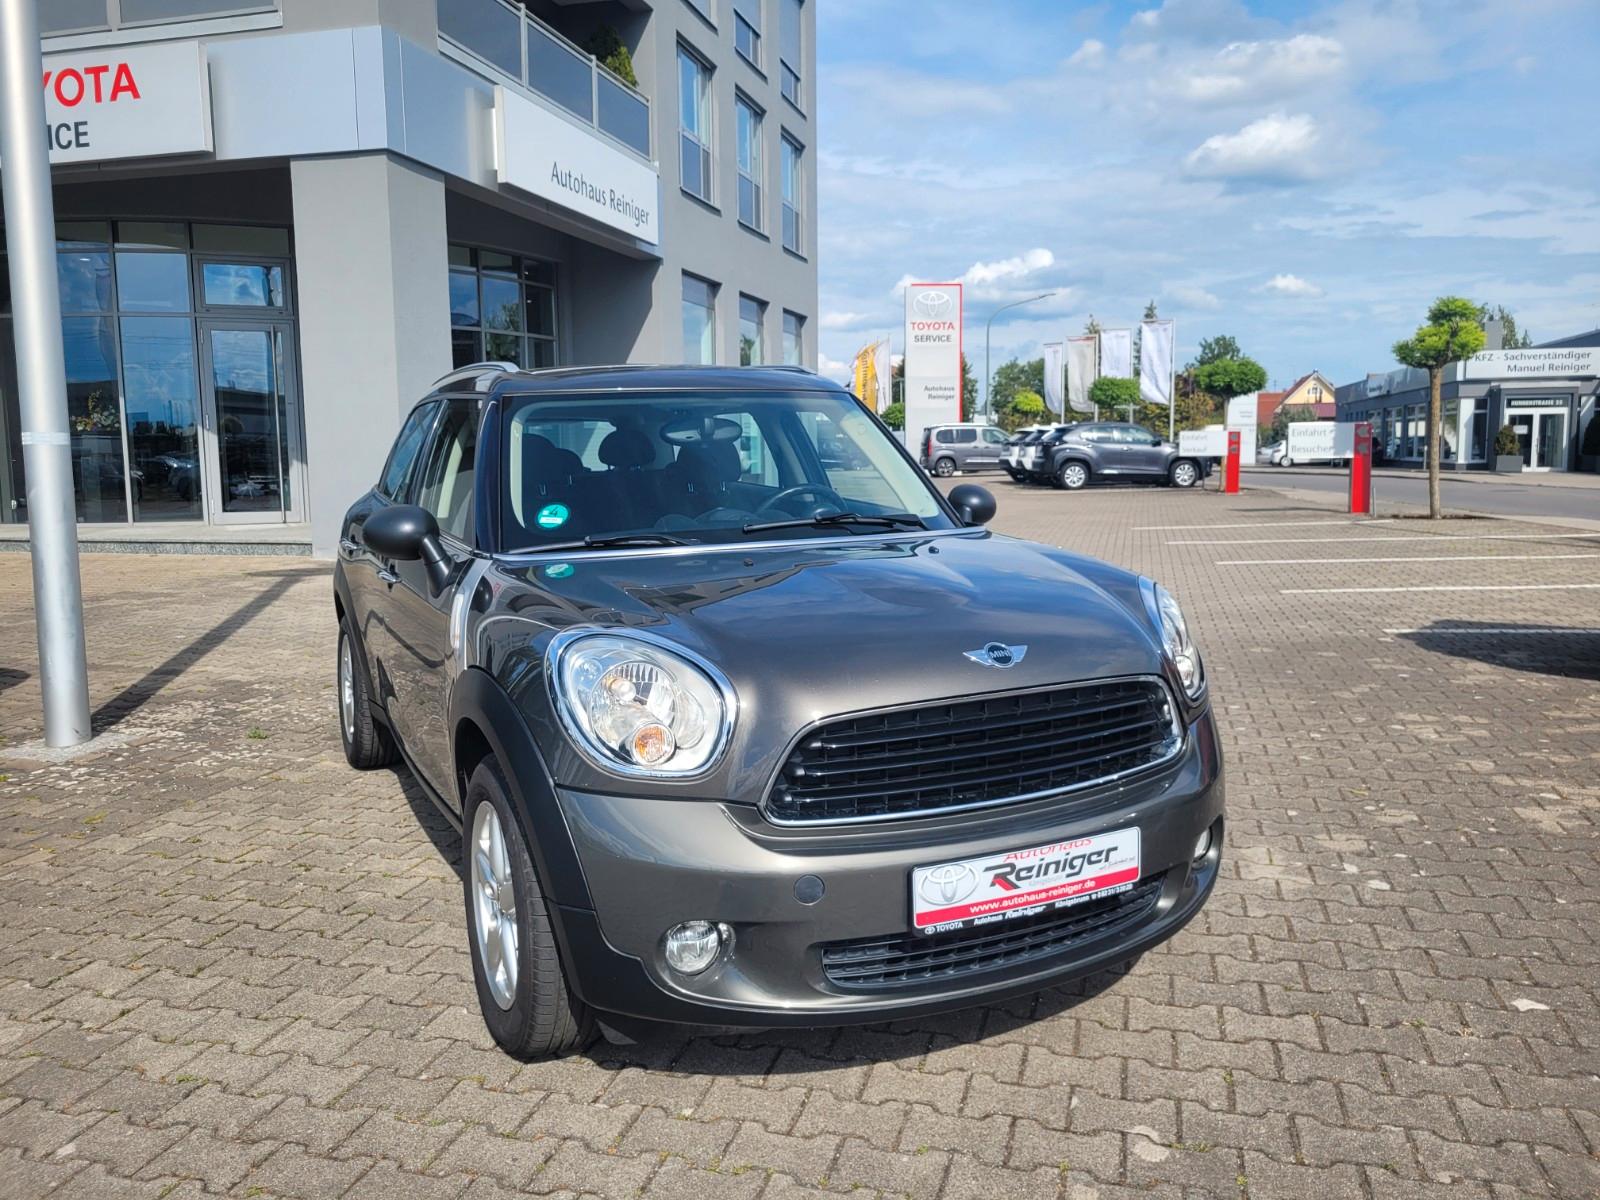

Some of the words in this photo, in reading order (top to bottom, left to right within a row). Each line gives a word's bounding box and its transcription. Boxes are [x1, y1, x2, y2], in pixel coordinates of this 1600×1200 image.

[551, 161, 607, 206] Autohaus
[609, 189, 650, 227] Reiniger
[911, 321, 955, 331] TOYOTA
[914, 334, 952, 343] SERVICE
[1475, 353, 1494, 361] KFZ
[1504, 351, 1592, 361] Sachverständiger
[1507, 363, 1545, 373] Manuel
[1548, 363, 1591, 373] Reiniger
[927, 393, 955, 401] Reiniger
[1291, 428, 1327, 437] Einfahrt
[1291, 445, 1335, 453] Besucher
[989, 649, 1011, 659] MINI
[1003, 838, 1093, 863] Autohaus
[982, 846, 1119, 892] Reiniger
[970, 880, 1096, 913] www.autohaus-reiniger.de
[936, 922, 963, 933] TOYOTA
[974, 914, 1004, 926] Autohaus
[1005, 905, 1047, 919] Reiniger
